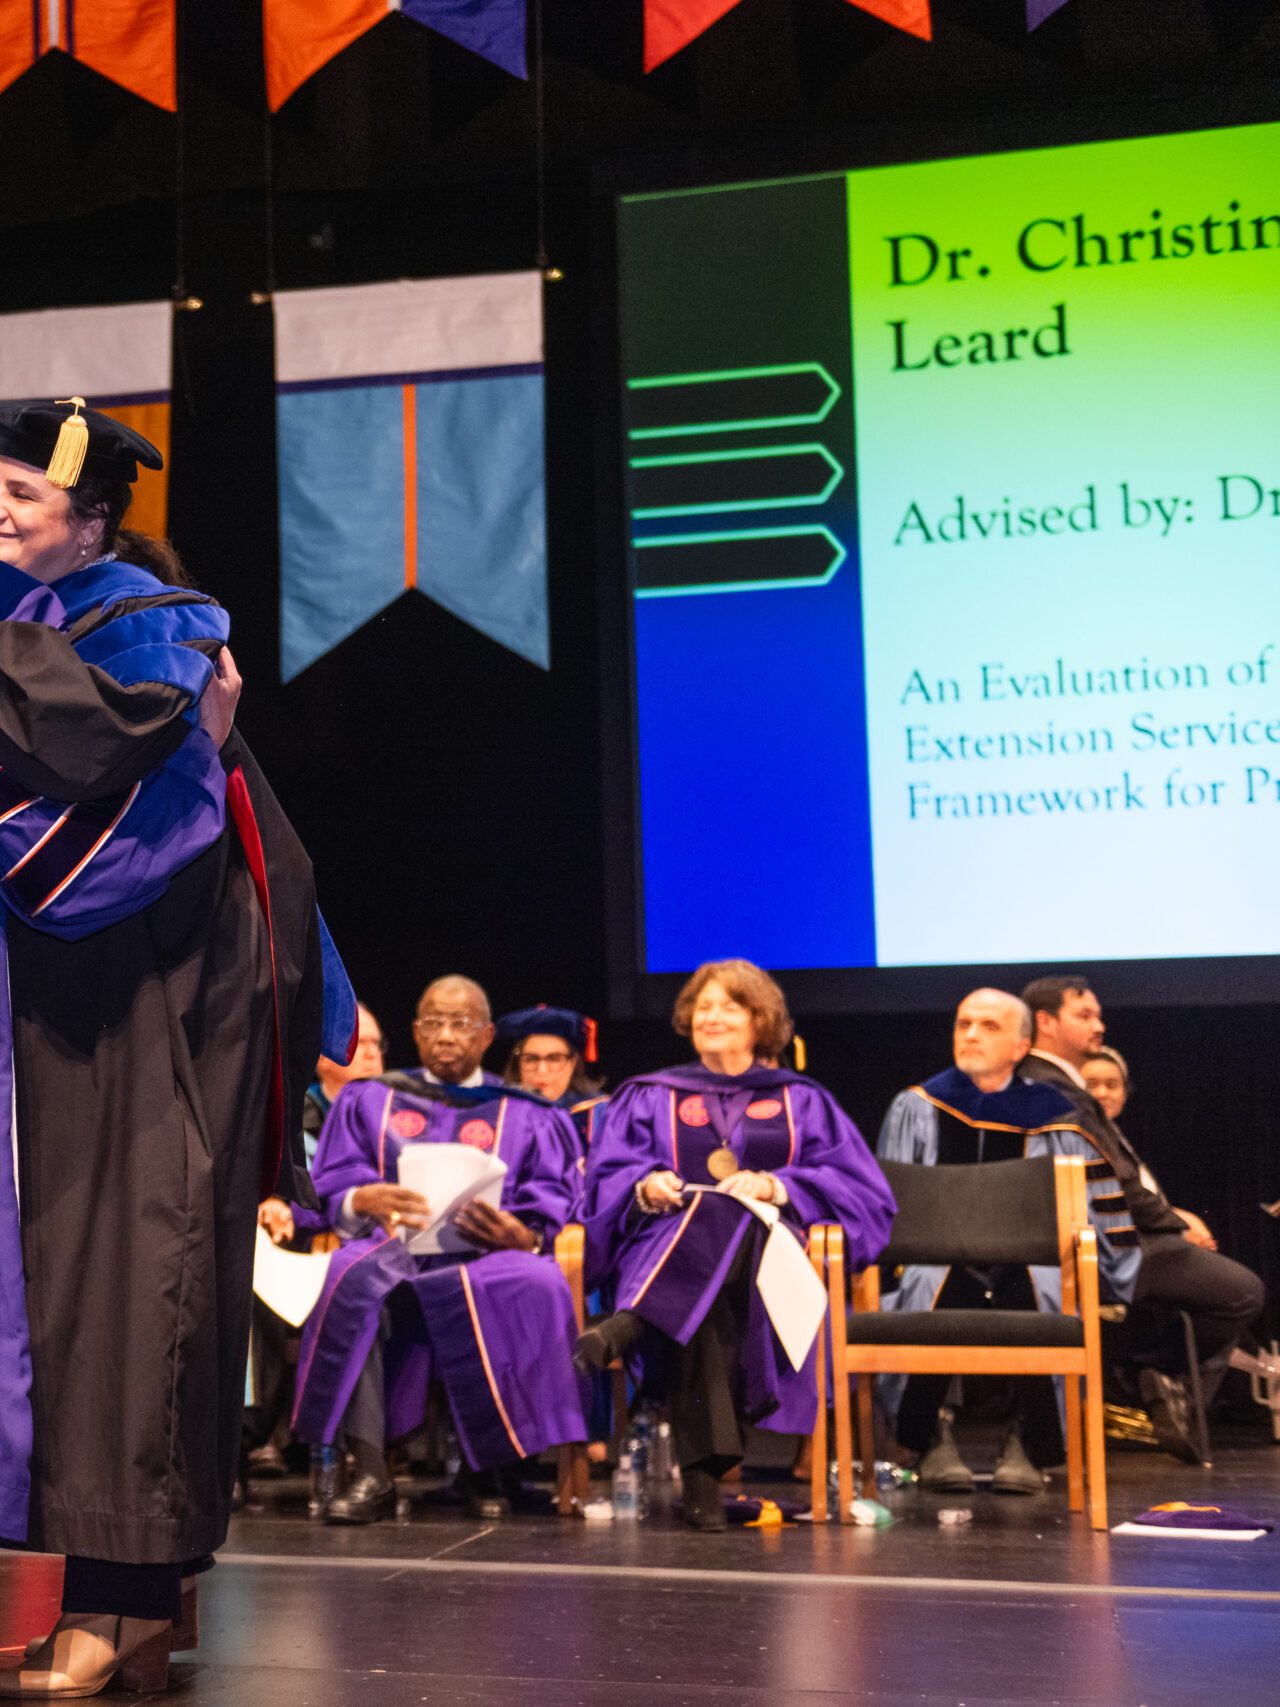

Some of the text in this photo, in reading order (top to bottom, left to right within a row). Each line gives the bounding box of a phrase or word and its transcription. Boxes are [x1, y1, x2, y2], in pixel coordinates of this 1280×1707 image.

[882, 198, 1280, 288] Dr. Christin
[884, 301, 1073, 372] Leard
[893, 485, 1100, 546] Advised
[1119, 482, 1194, 538] by:
[900, 644, 1275, 705] An Evaluation of
[905, 711, 1280, 763] Extension Service
[908, 771, 1147, 820] Framework
[1164, 767, 1226, 808] for
